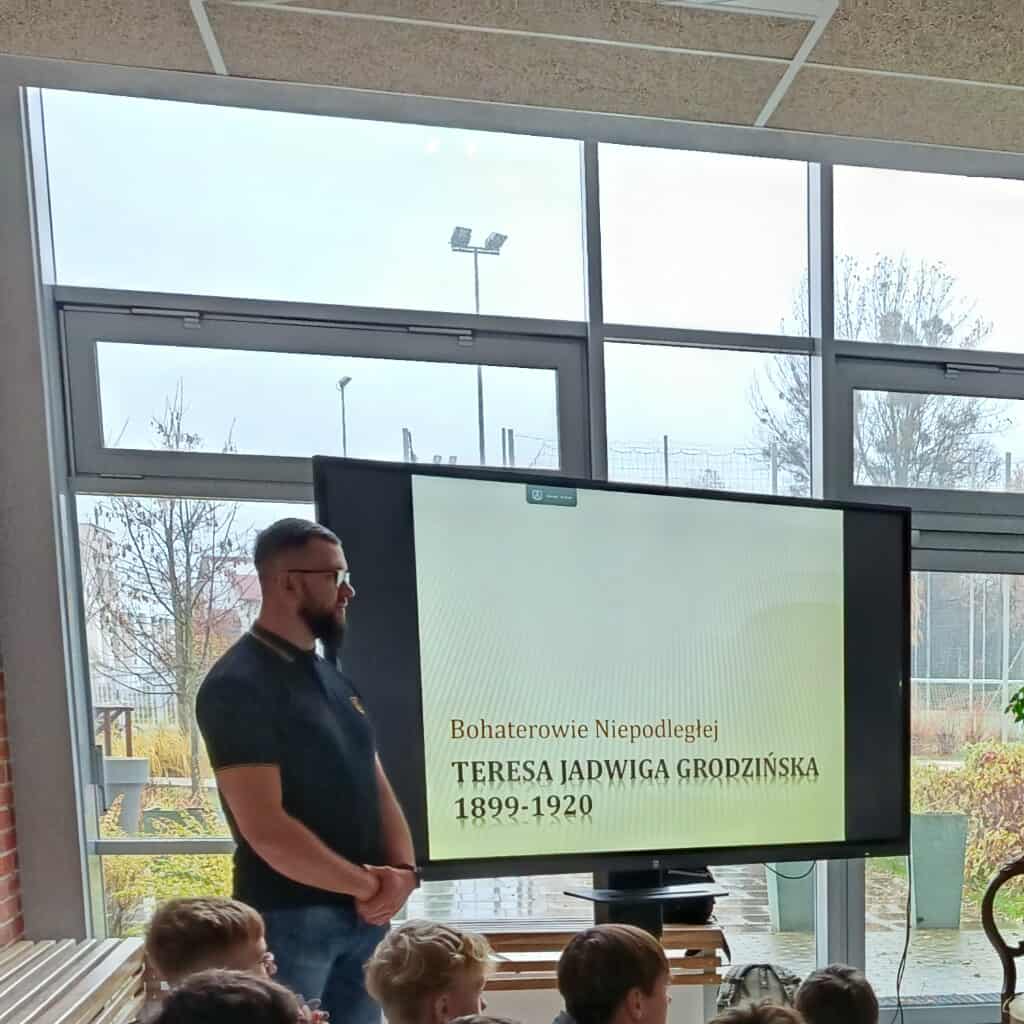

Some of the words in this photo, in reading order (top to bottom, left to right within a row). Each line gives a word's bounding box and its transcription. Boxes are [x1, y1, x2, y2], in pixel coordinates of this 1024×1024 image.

[451, 719, 589, 740] Bohaterowie
[595, 718, 719, 744] Niepodległej
[451, 760, 553, 783] TERESA
[560, 758, 670, 785] JADWIGA
[676, 751, 820, 779] GRODZIŃSKA
[454, 794, 594, 820] 1899-1920
